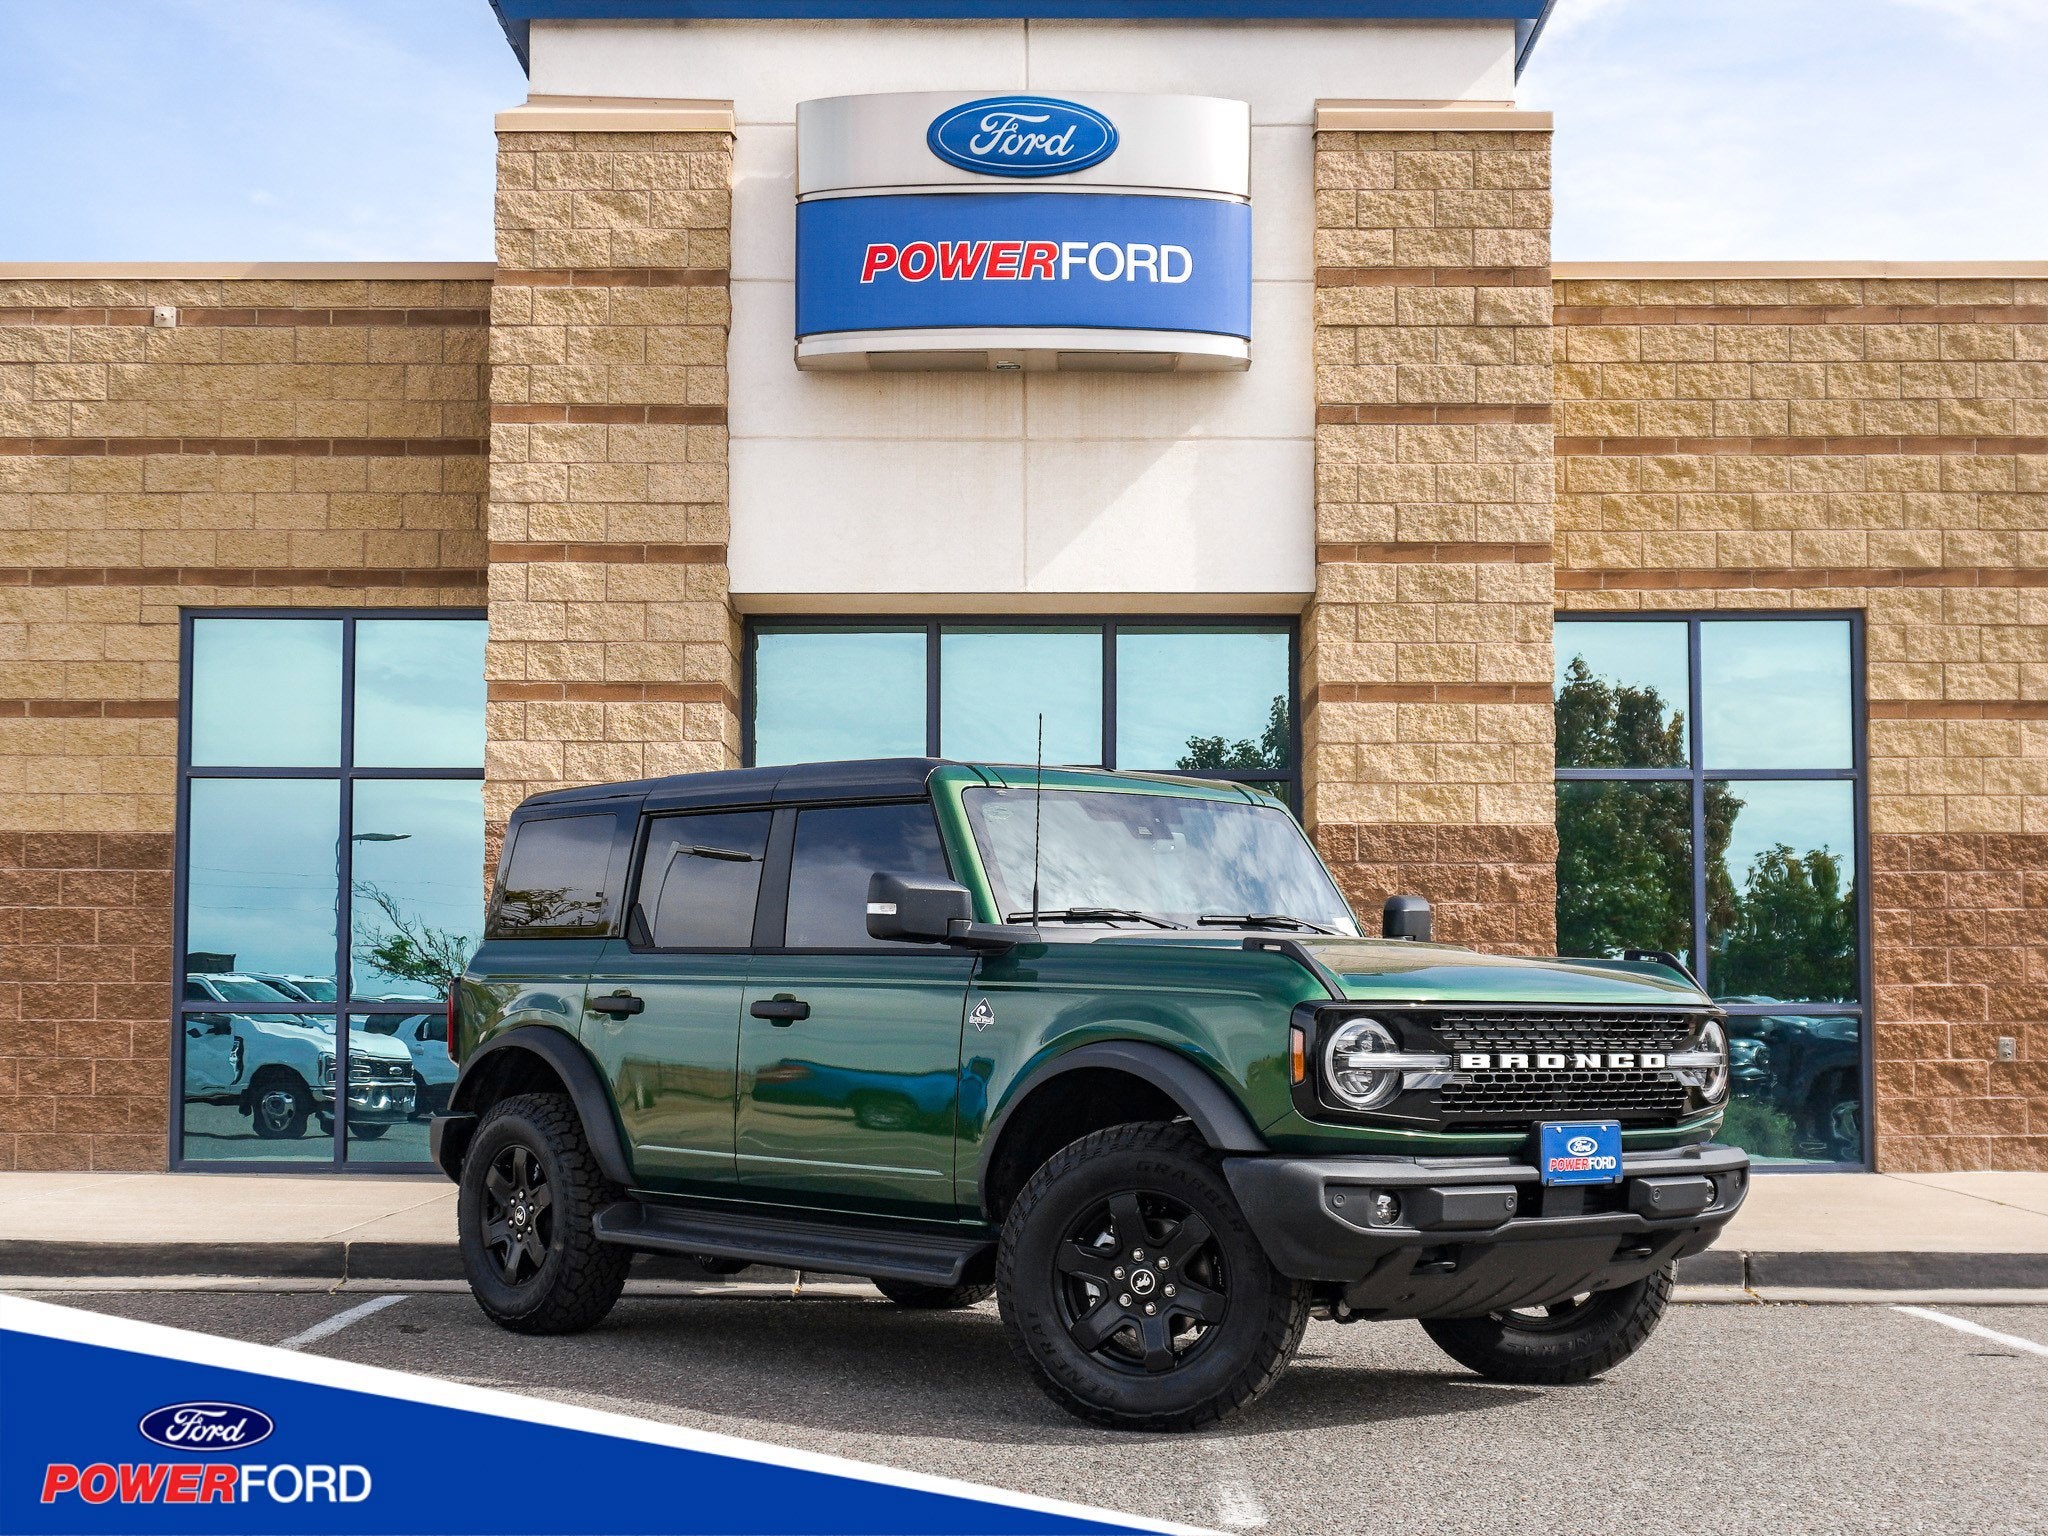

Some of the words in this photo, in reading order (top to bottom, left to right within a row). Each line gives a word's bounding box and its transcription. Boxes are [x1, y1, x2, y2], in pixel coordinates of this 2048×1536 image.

[969, 111, 1077, 156] Ford
[1460, 1053, 1666, 1069] BRONCO
[1573, 1140, 1592, 1152] Ford
